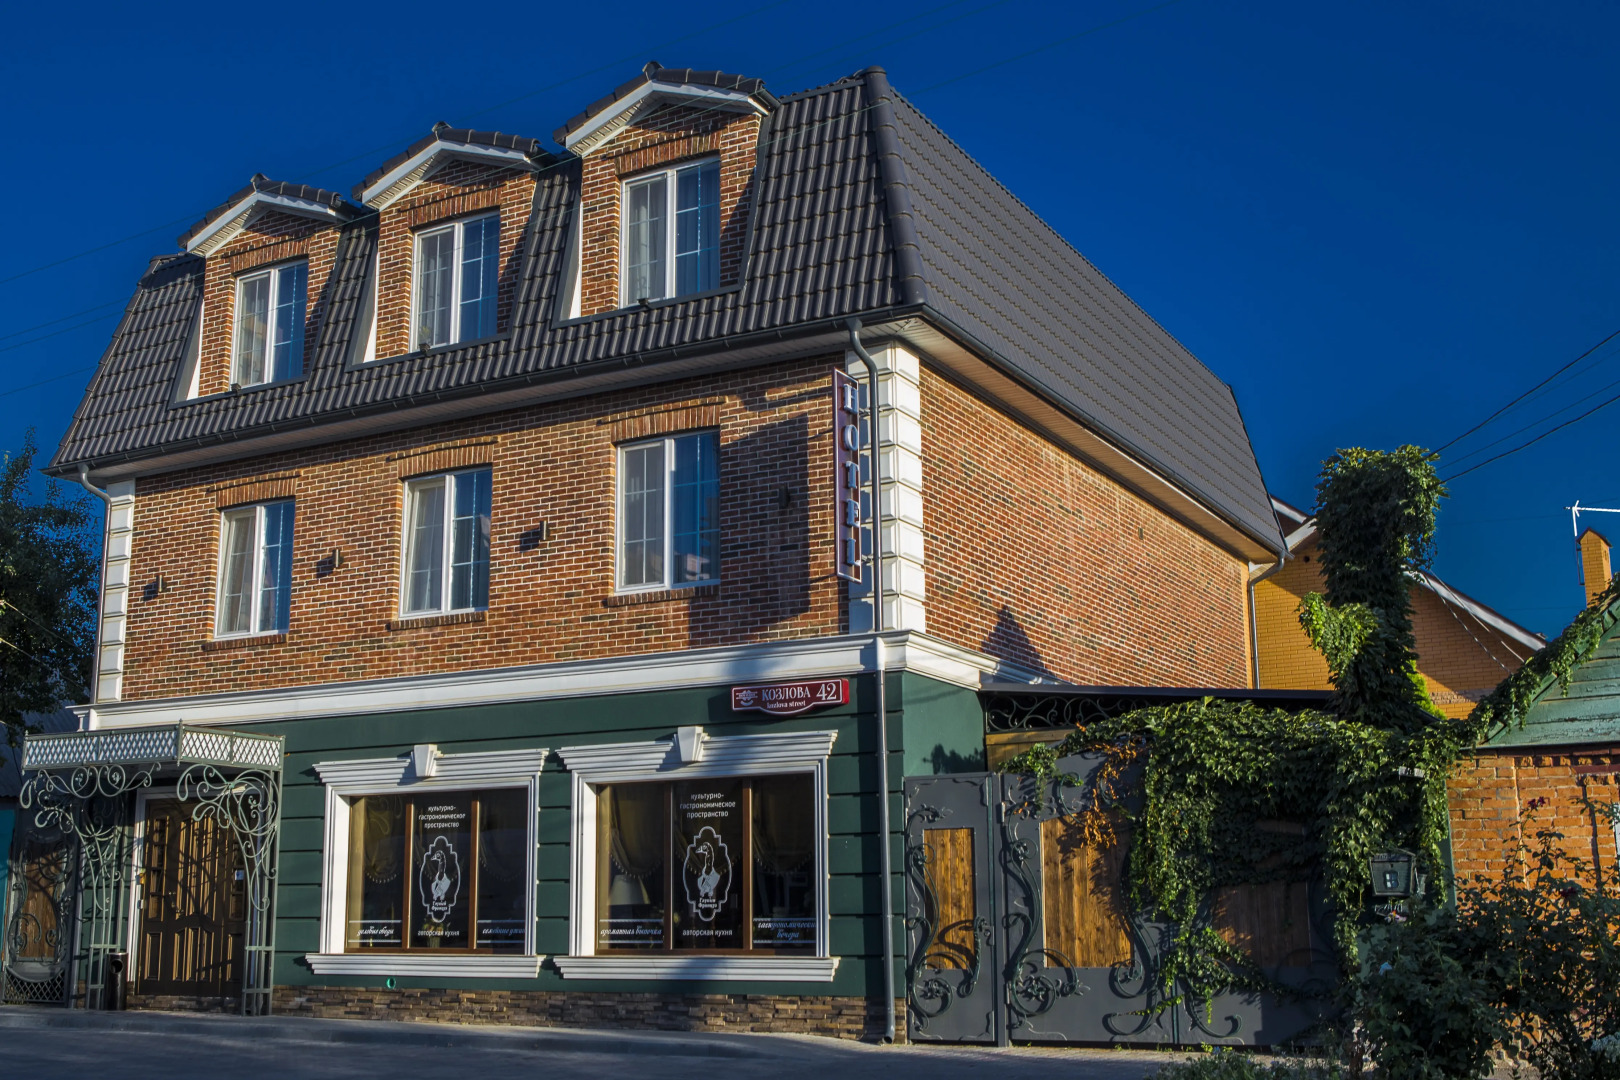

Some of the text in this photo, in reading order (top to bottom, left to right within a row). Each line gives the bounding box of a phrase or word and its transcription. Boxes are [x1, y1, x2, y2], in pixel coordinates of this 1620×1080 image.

[843, 383, 860, 566] HOTEL
[761, 682, 837, 701] КОЗЛОВА 42
[690, 792, 724, 800] культурно-
[679, 801, 736, 809] гастрономическое
[687, 810, 729, 819] пространство
[424, 821, 460, 829] пространство
